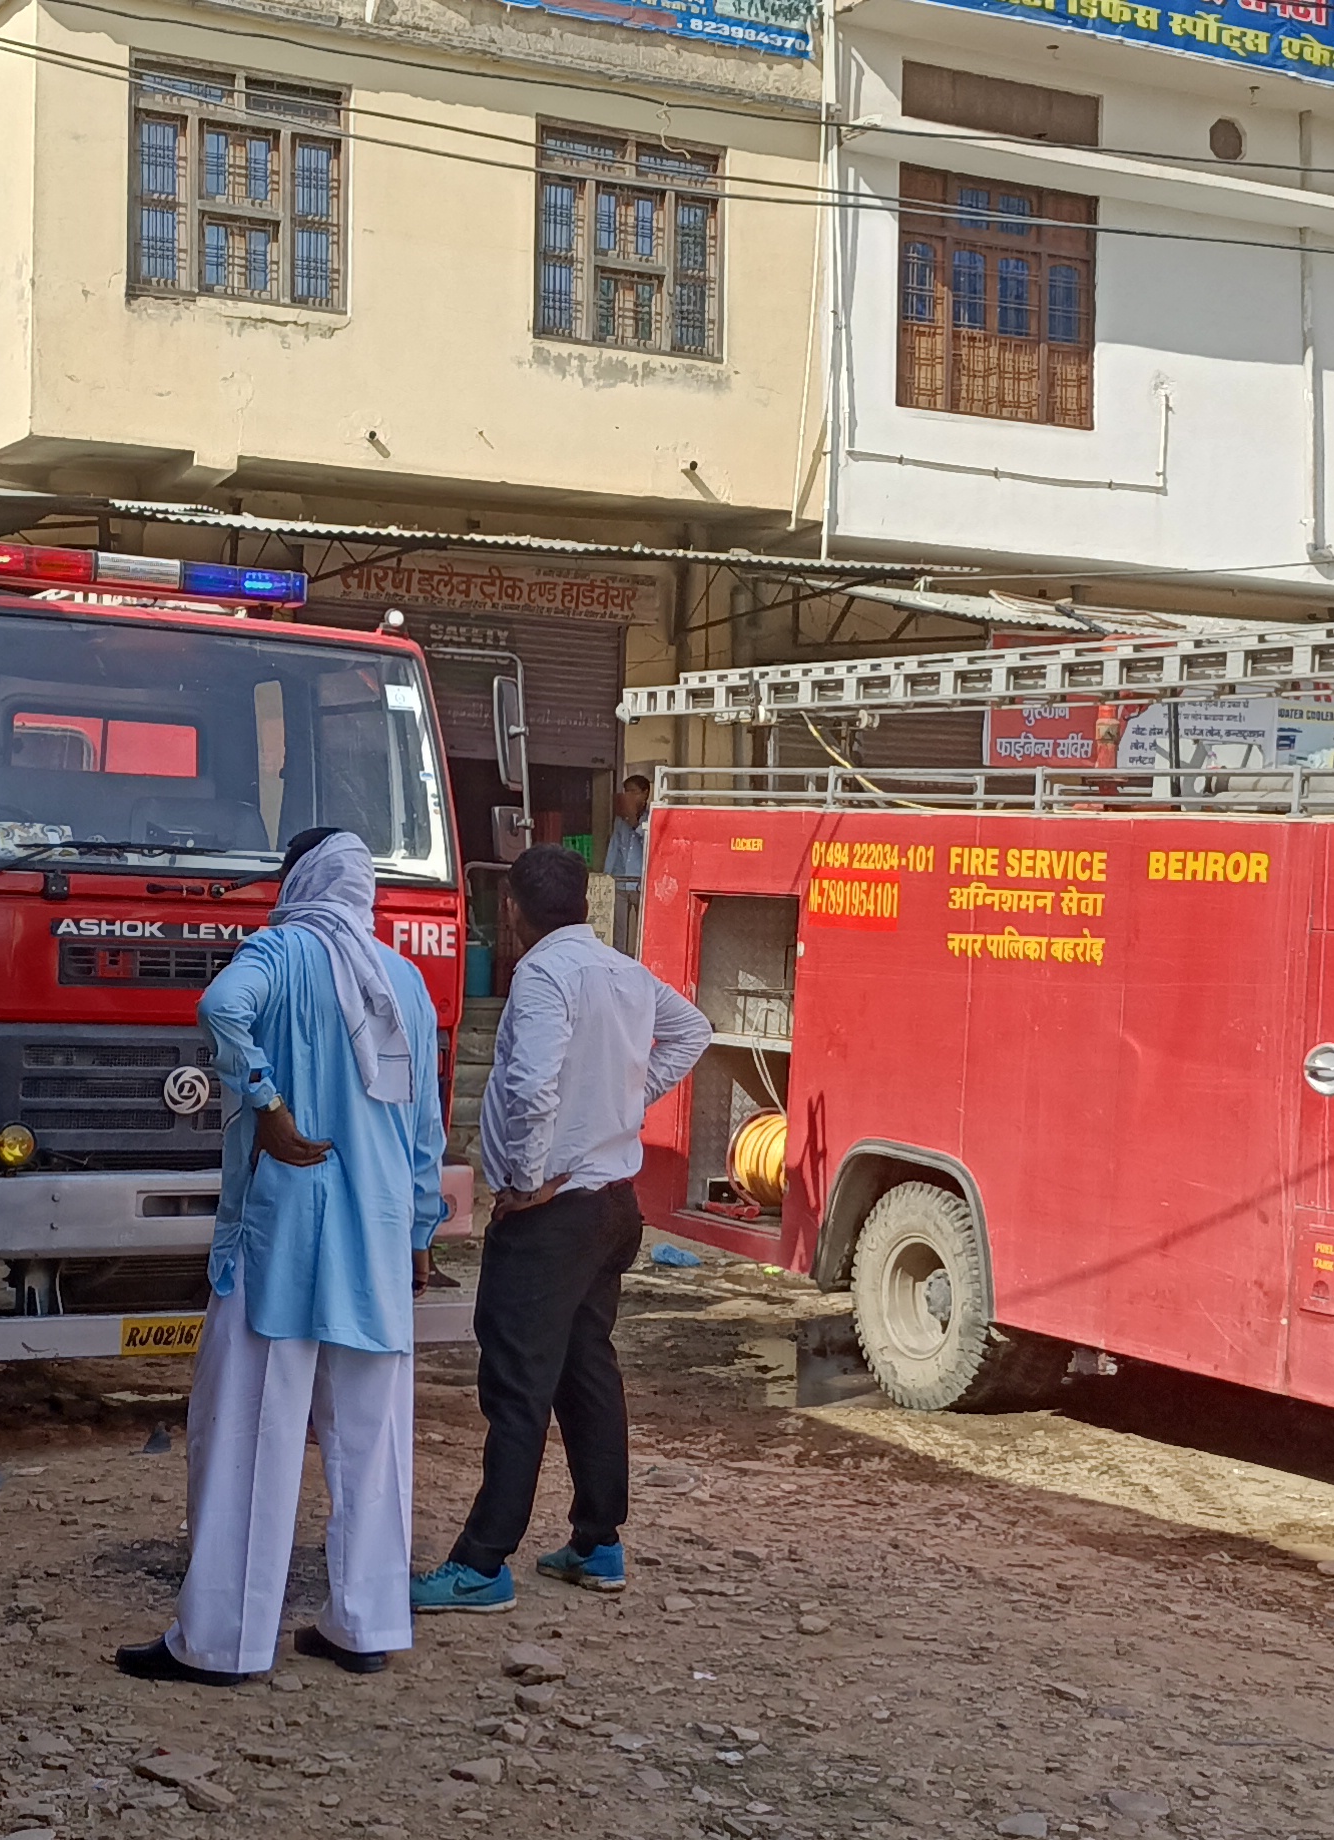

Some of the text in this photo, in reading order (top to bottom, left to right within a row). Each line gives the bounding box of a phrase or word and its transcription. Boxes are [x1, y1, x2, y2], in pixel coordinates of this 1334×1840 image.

[1306, 710, 1334, 721] COOLER
[730, 838, 763, 851] LOCKER
[811, 841, 849, 869] 01494
[948, 847, 1269, 883] FIRE SERVICE BEHROR
[948, 881, 1106, 917] अग्निशमन सेवा
[57, 920, 260, 940] ASHOK LEYL
[393, 921, 457, 957] FIRE
[947, 931, 984, 958] नगर
[986, 925, 1048, 961] पालिका
